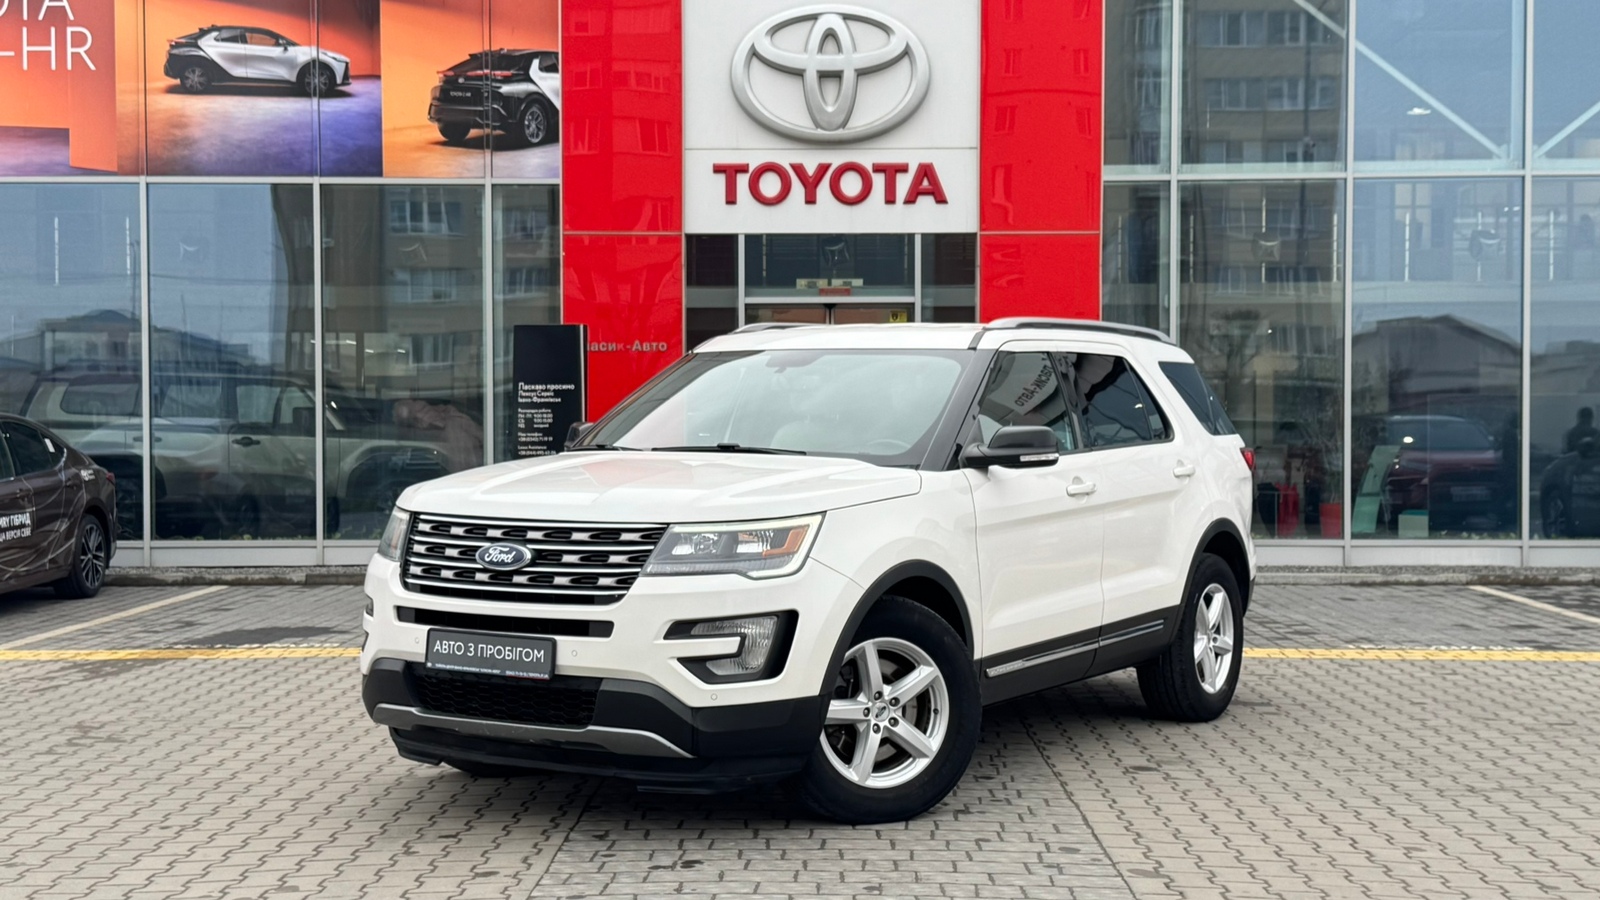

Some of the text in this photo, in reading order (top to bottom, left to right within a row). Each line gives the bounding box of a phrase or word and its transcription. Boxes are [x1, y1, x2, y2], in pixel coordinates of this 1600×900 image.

[712, 161, 949, 206] TOYOTA
[586, 339, 667, 352] асик-Авто
[484, 546, 517, 563] Ford
[433, 639, 465, 656] АВТО
[478, 644, 545, 663] ПРОБІГОМ
